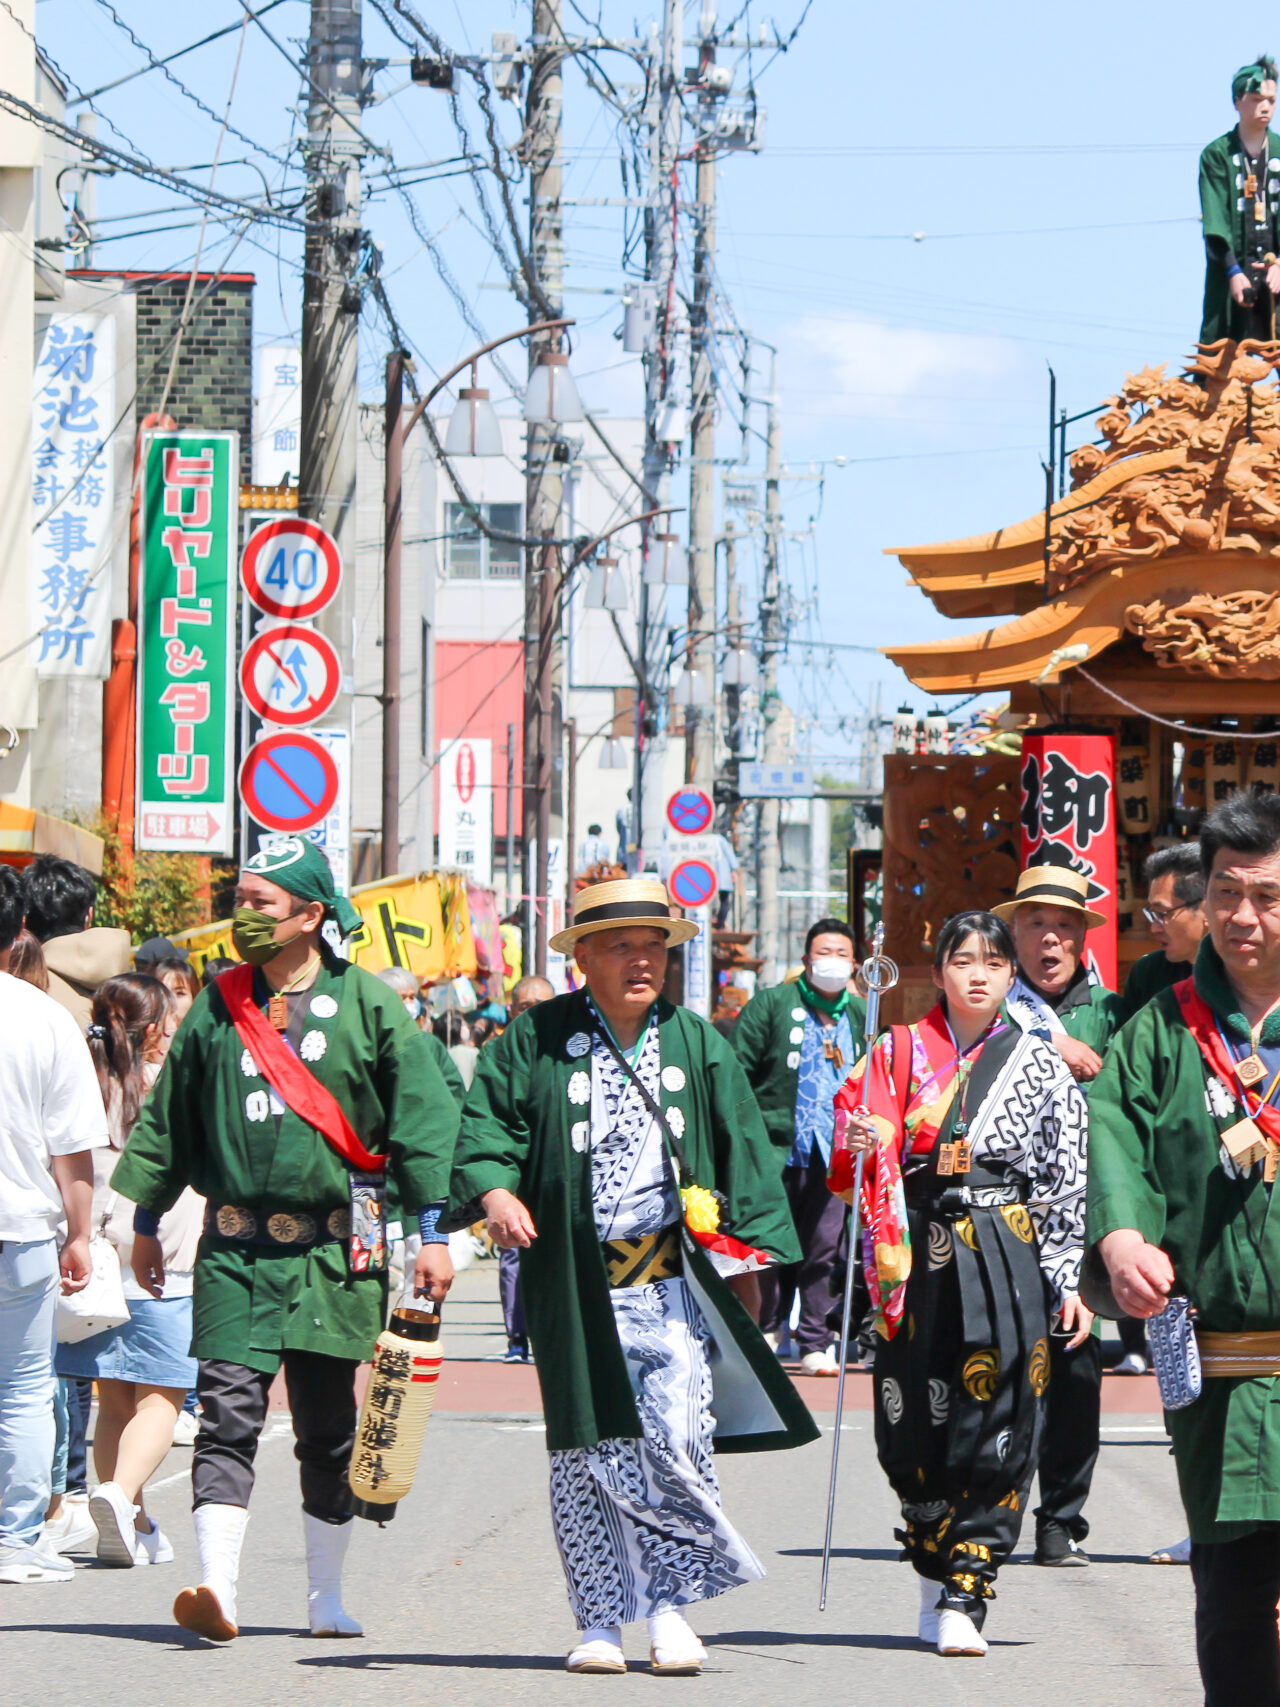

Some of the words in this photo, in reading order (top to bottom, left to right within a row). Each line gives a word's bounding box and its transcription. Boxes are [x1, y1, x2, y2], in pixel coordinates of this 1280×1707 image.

[40, 325, 99, 434] 菊池
[274, 364, 298, 452] 宝飾
[33, 437, 65, 506] 会計
[71, 438, 108, 508] 税務
[37, 511, 98, 667] 事務所
[265, 548, 319, 592] 40
[147, 815, 209, 838] 駐車場
